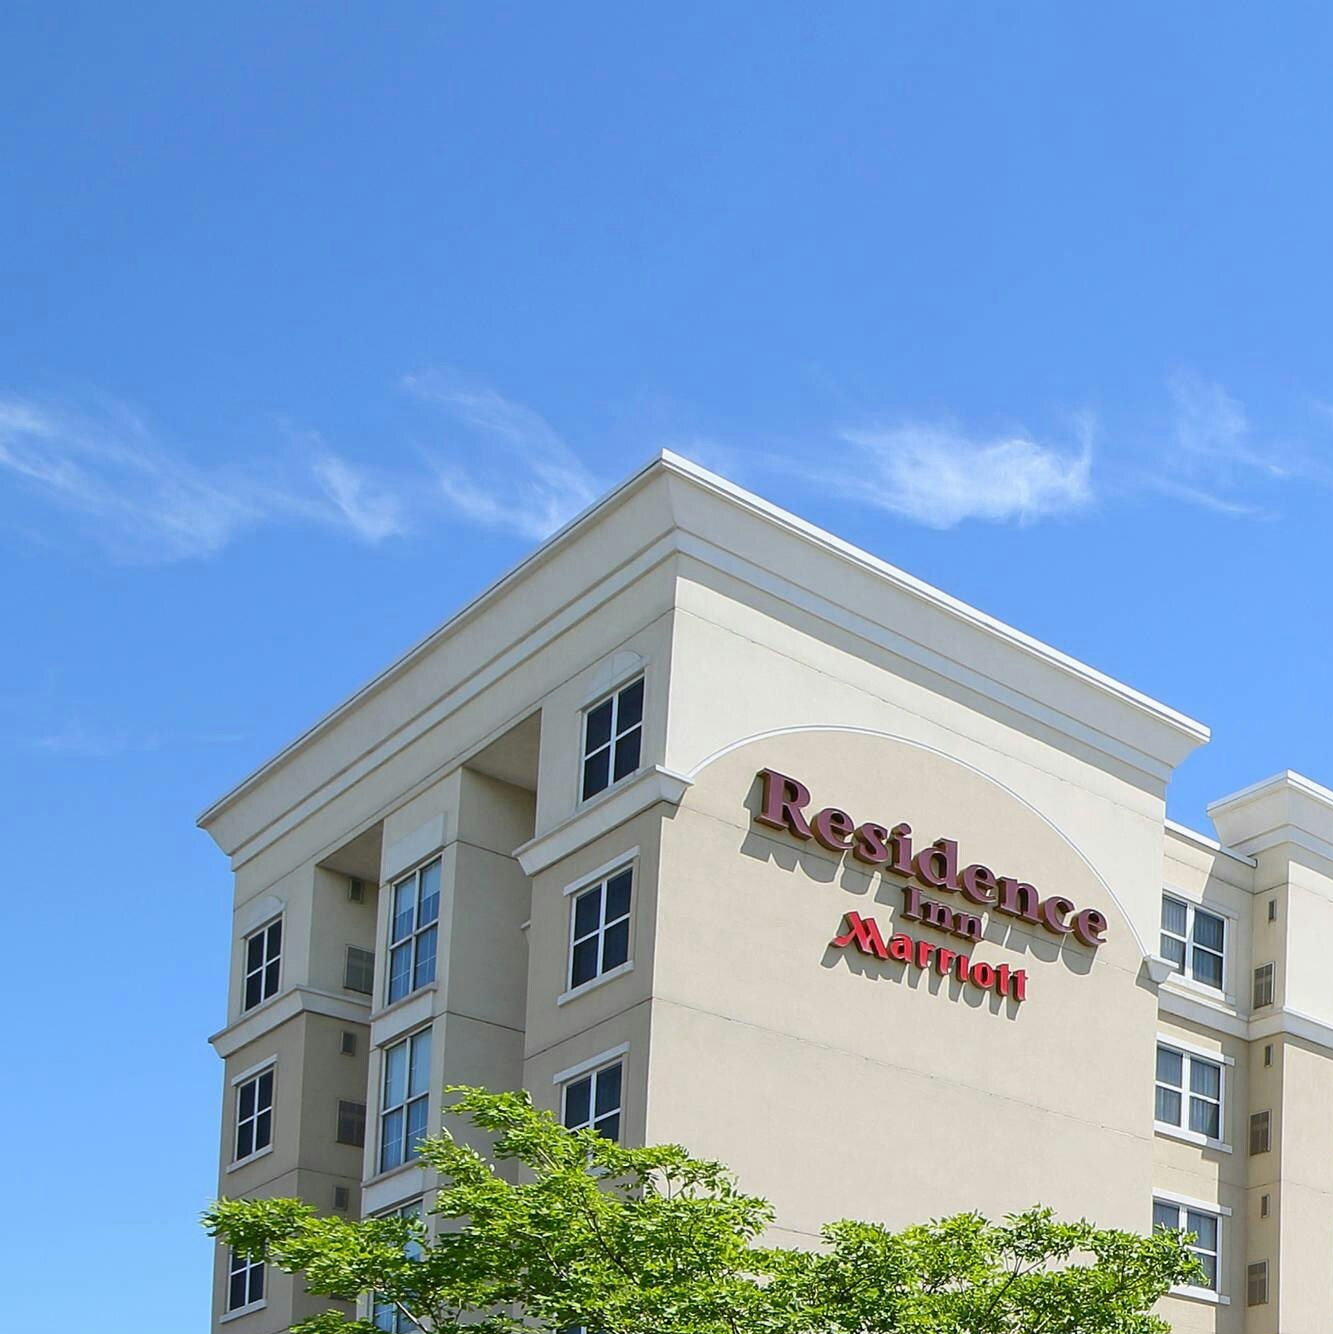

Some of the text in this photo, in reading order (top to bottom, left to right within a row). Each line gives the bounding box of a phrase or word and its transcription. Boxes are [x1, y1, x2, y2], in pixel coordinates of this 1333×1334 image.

[753, 767, 1108, 948] Residence
[829, 911, 1029, 1002] Marriott
[902, 885, 984, 943] Inn
